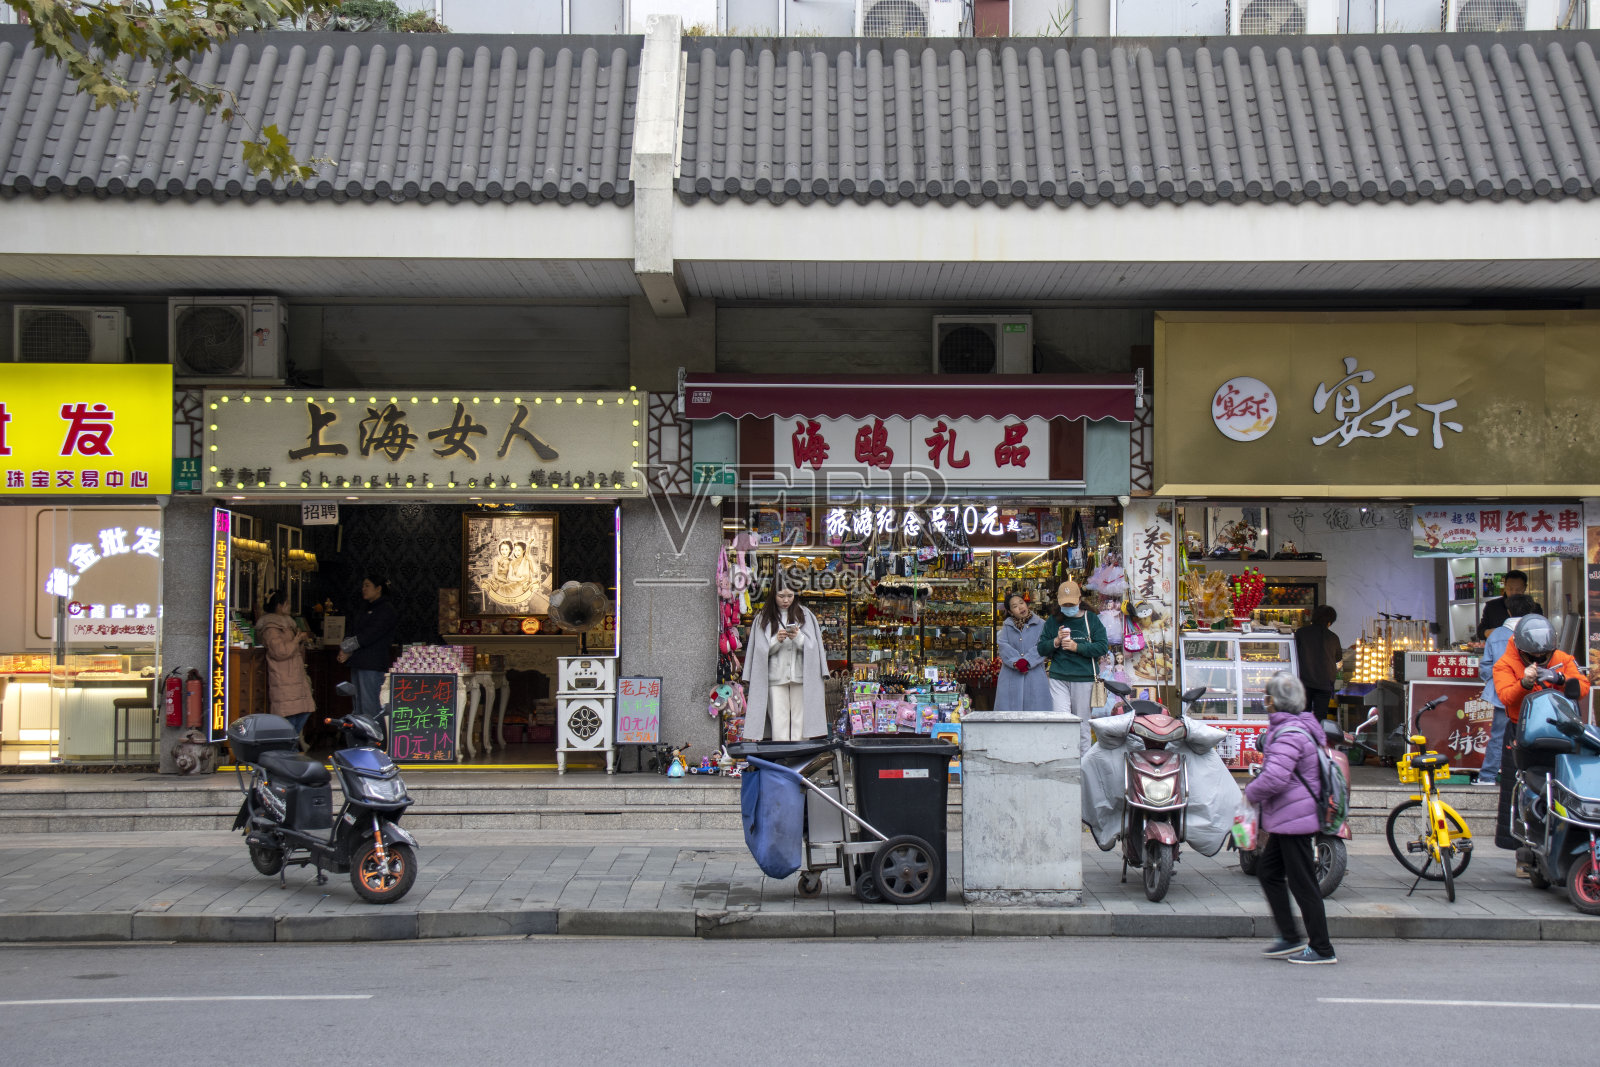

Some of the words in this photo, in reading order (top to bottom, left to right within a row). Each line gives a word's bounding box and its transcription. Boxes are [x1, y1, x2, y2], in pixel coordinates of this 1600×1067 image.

[1215, 384, 1270, 421] 宴天下
[1312, 357, 1464, 449] 宴天下
[289, 403, 559, 462] 上海女人
[182, 461, 197, 472] 11
[7, 471, 148, 488] 珠宝交易中心
[303, 504, 337, 521] 招聘
[1451, 512, 1478, 524] 超级
[1480, 509, 1581, 533] 网红大串
[213, 540, 227, 730] 雪花膏专卖店
[394, 679, 453, 703] 老上海
[620, 679, 660, 698] 老上海
[392, 706, 453, 732] 雪花膏
